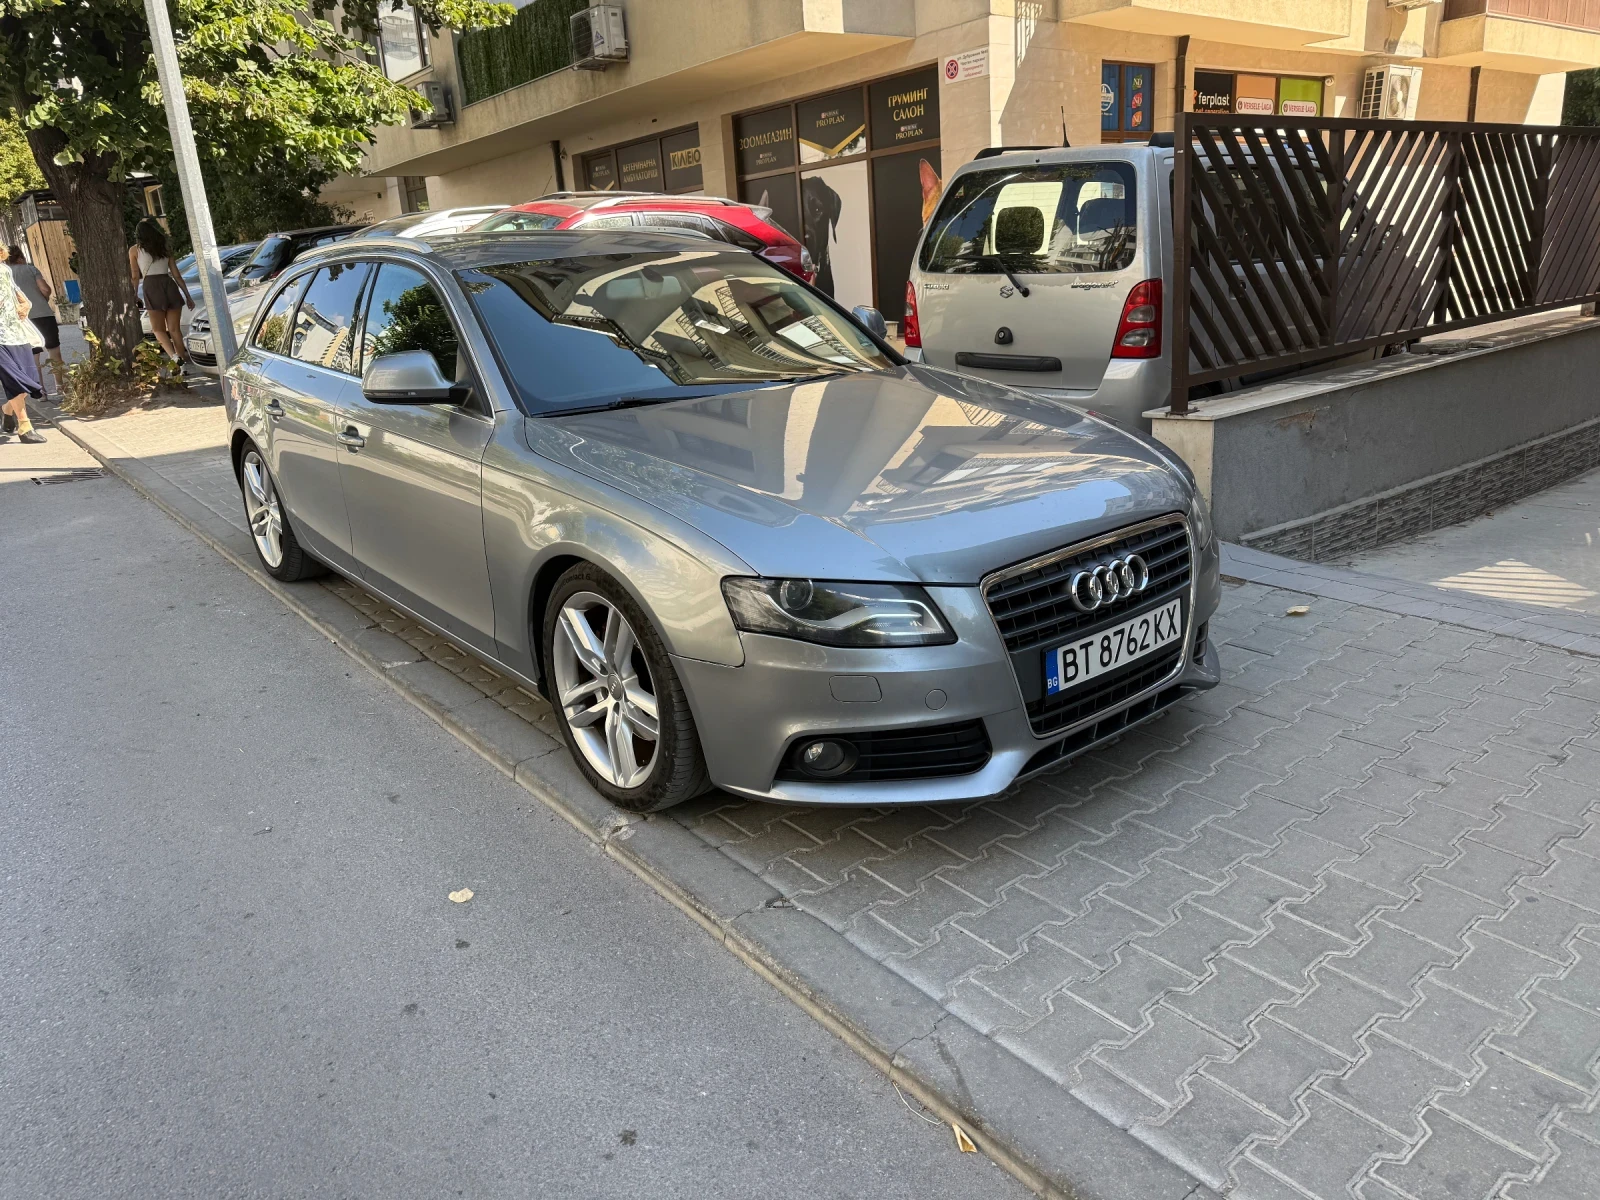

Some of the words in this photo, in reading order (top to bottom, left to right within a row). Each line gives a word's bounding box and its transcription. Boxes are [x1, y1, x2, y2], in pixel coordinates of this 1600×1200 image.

[888, 87, 929, 108] ГРУМИНГ
[1198, 91, 1230, 108] ferplast
[893, 103, 924, 122] САЛОН
[1243, 101, 1272, 111] VERSELE-LAGA
[1288, 104, 1315, 113] VERSELE-LAGA
[816, 118, 829, 128] PRO
[829, 114, 845, 125] PLAN
[739, 127, 792, 150] ЗООМАГАЗИН
[895, 131, 908, 140] PRO
[908, 128, 924, 138] PLAN
[622, 158, 657, 173] ВЕТЕРИНАРНА
[671, 148, 701, 168] КЛЕО
[1062, 640, 1094, 684] BT
[1100, 618, 1150, 667] 8762
[1154, 604, 1178, 645] KX
[1047, 676, 1058, 689] BG
